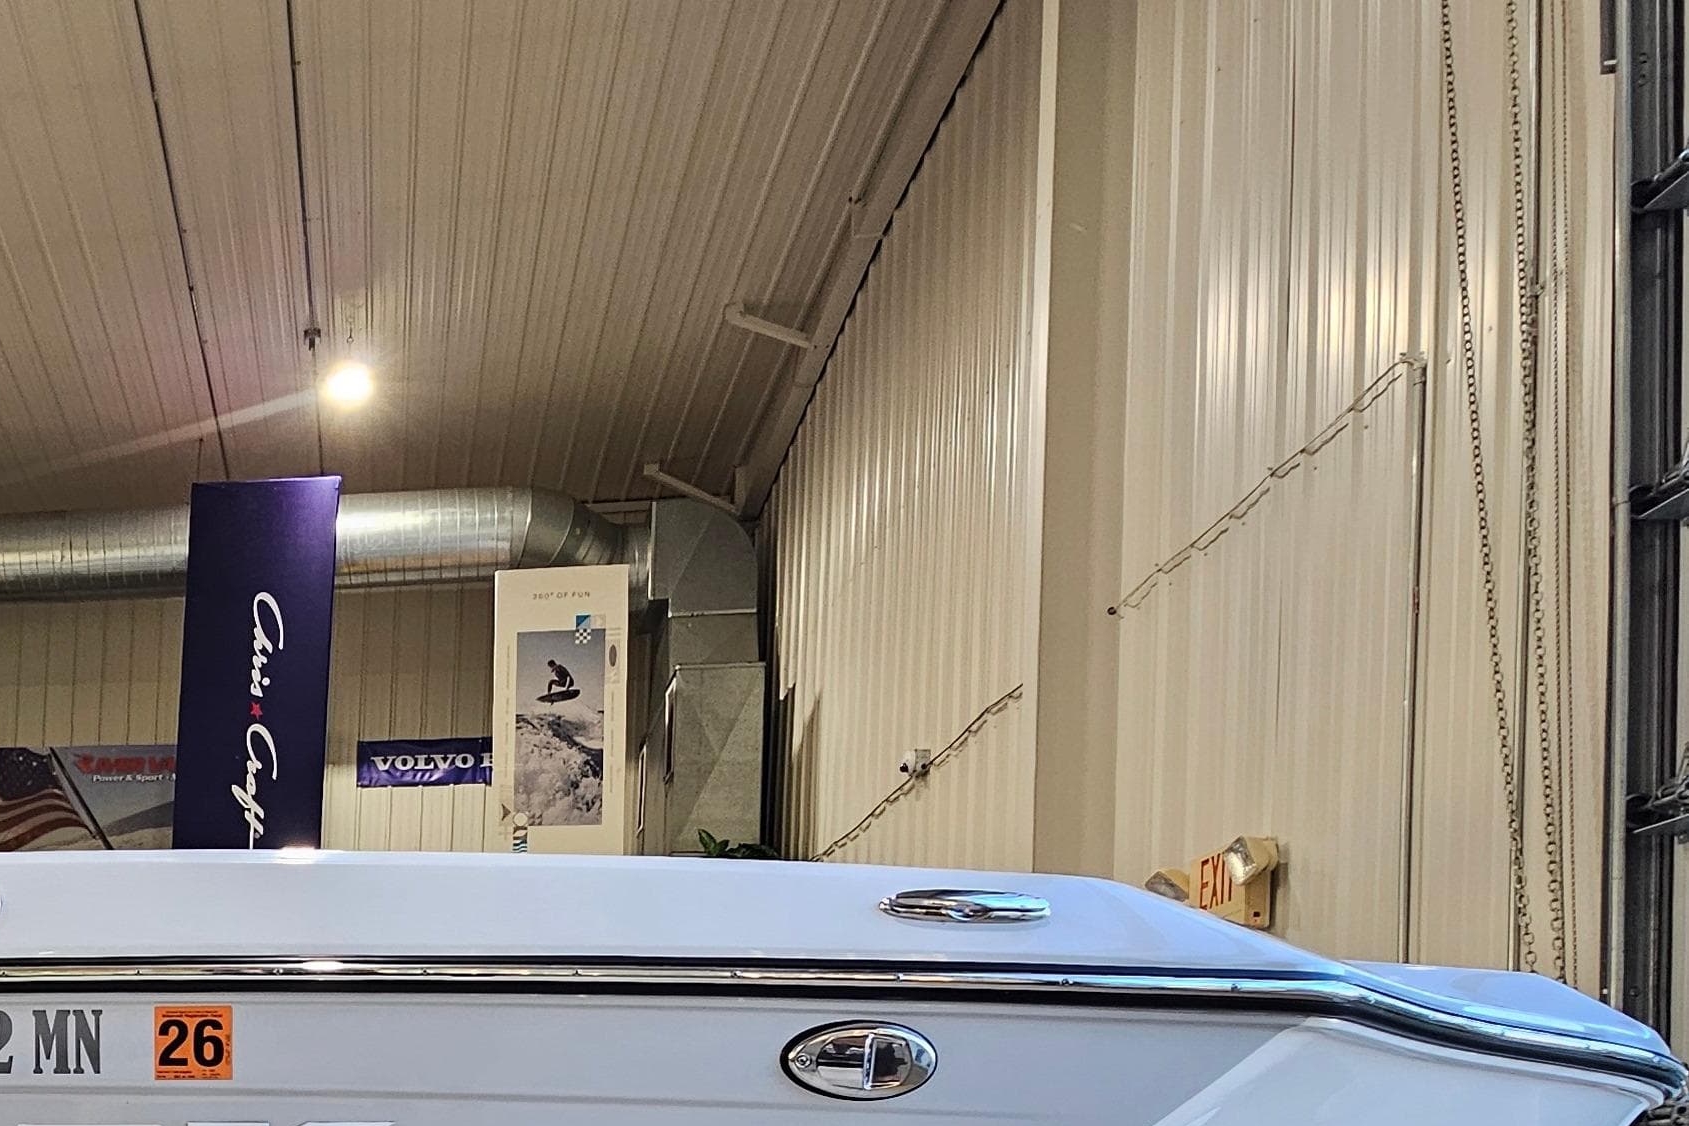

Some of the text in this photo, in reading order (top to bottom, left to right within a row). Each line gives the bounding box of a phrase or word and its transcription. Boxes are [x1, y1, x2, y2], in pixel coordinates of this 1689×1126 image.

[92, 774, 126, 783] Power
[135, 773, 163, 784] Sport
[370, 753, 475, 771] VOLVO
[33, 1008, 103, 1075] MN
[158, 1018, 225, 1068] 26
